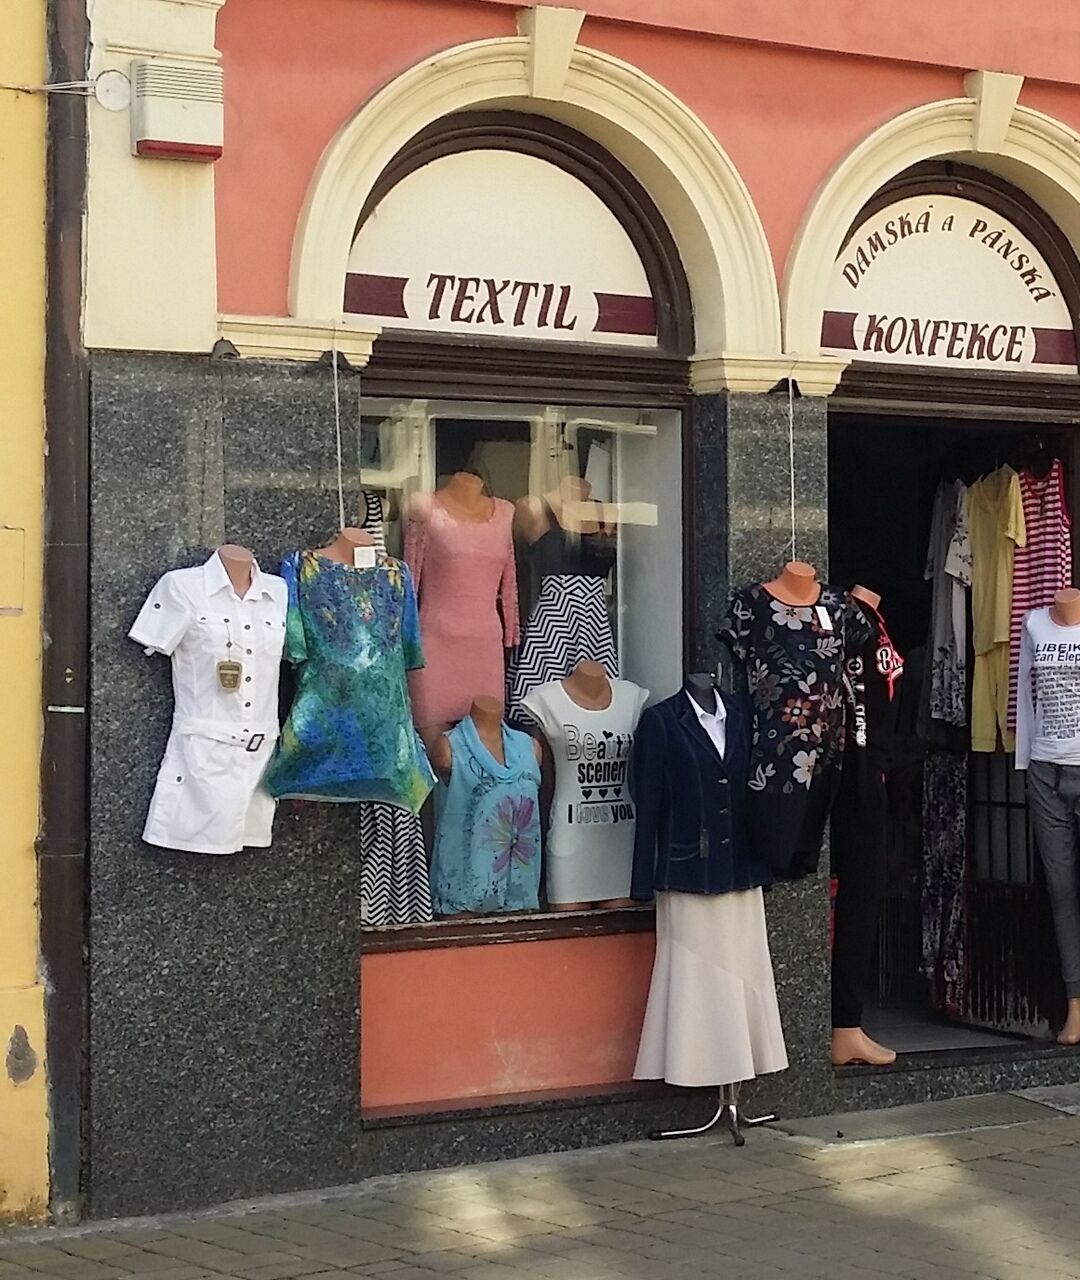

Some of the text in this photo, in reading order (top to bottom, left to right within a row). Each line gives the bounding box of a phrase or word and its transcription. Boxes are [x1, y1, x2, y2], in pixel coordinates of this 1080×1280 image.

[968, 219, 1056, 303] PÁNSKÁ
[426, 273, 577, 331] TEXTIL
[862, 314, 1026, 363] KONFEKCE
[567, 804, 573, 824] I
[576, 804, 609, 824] love
